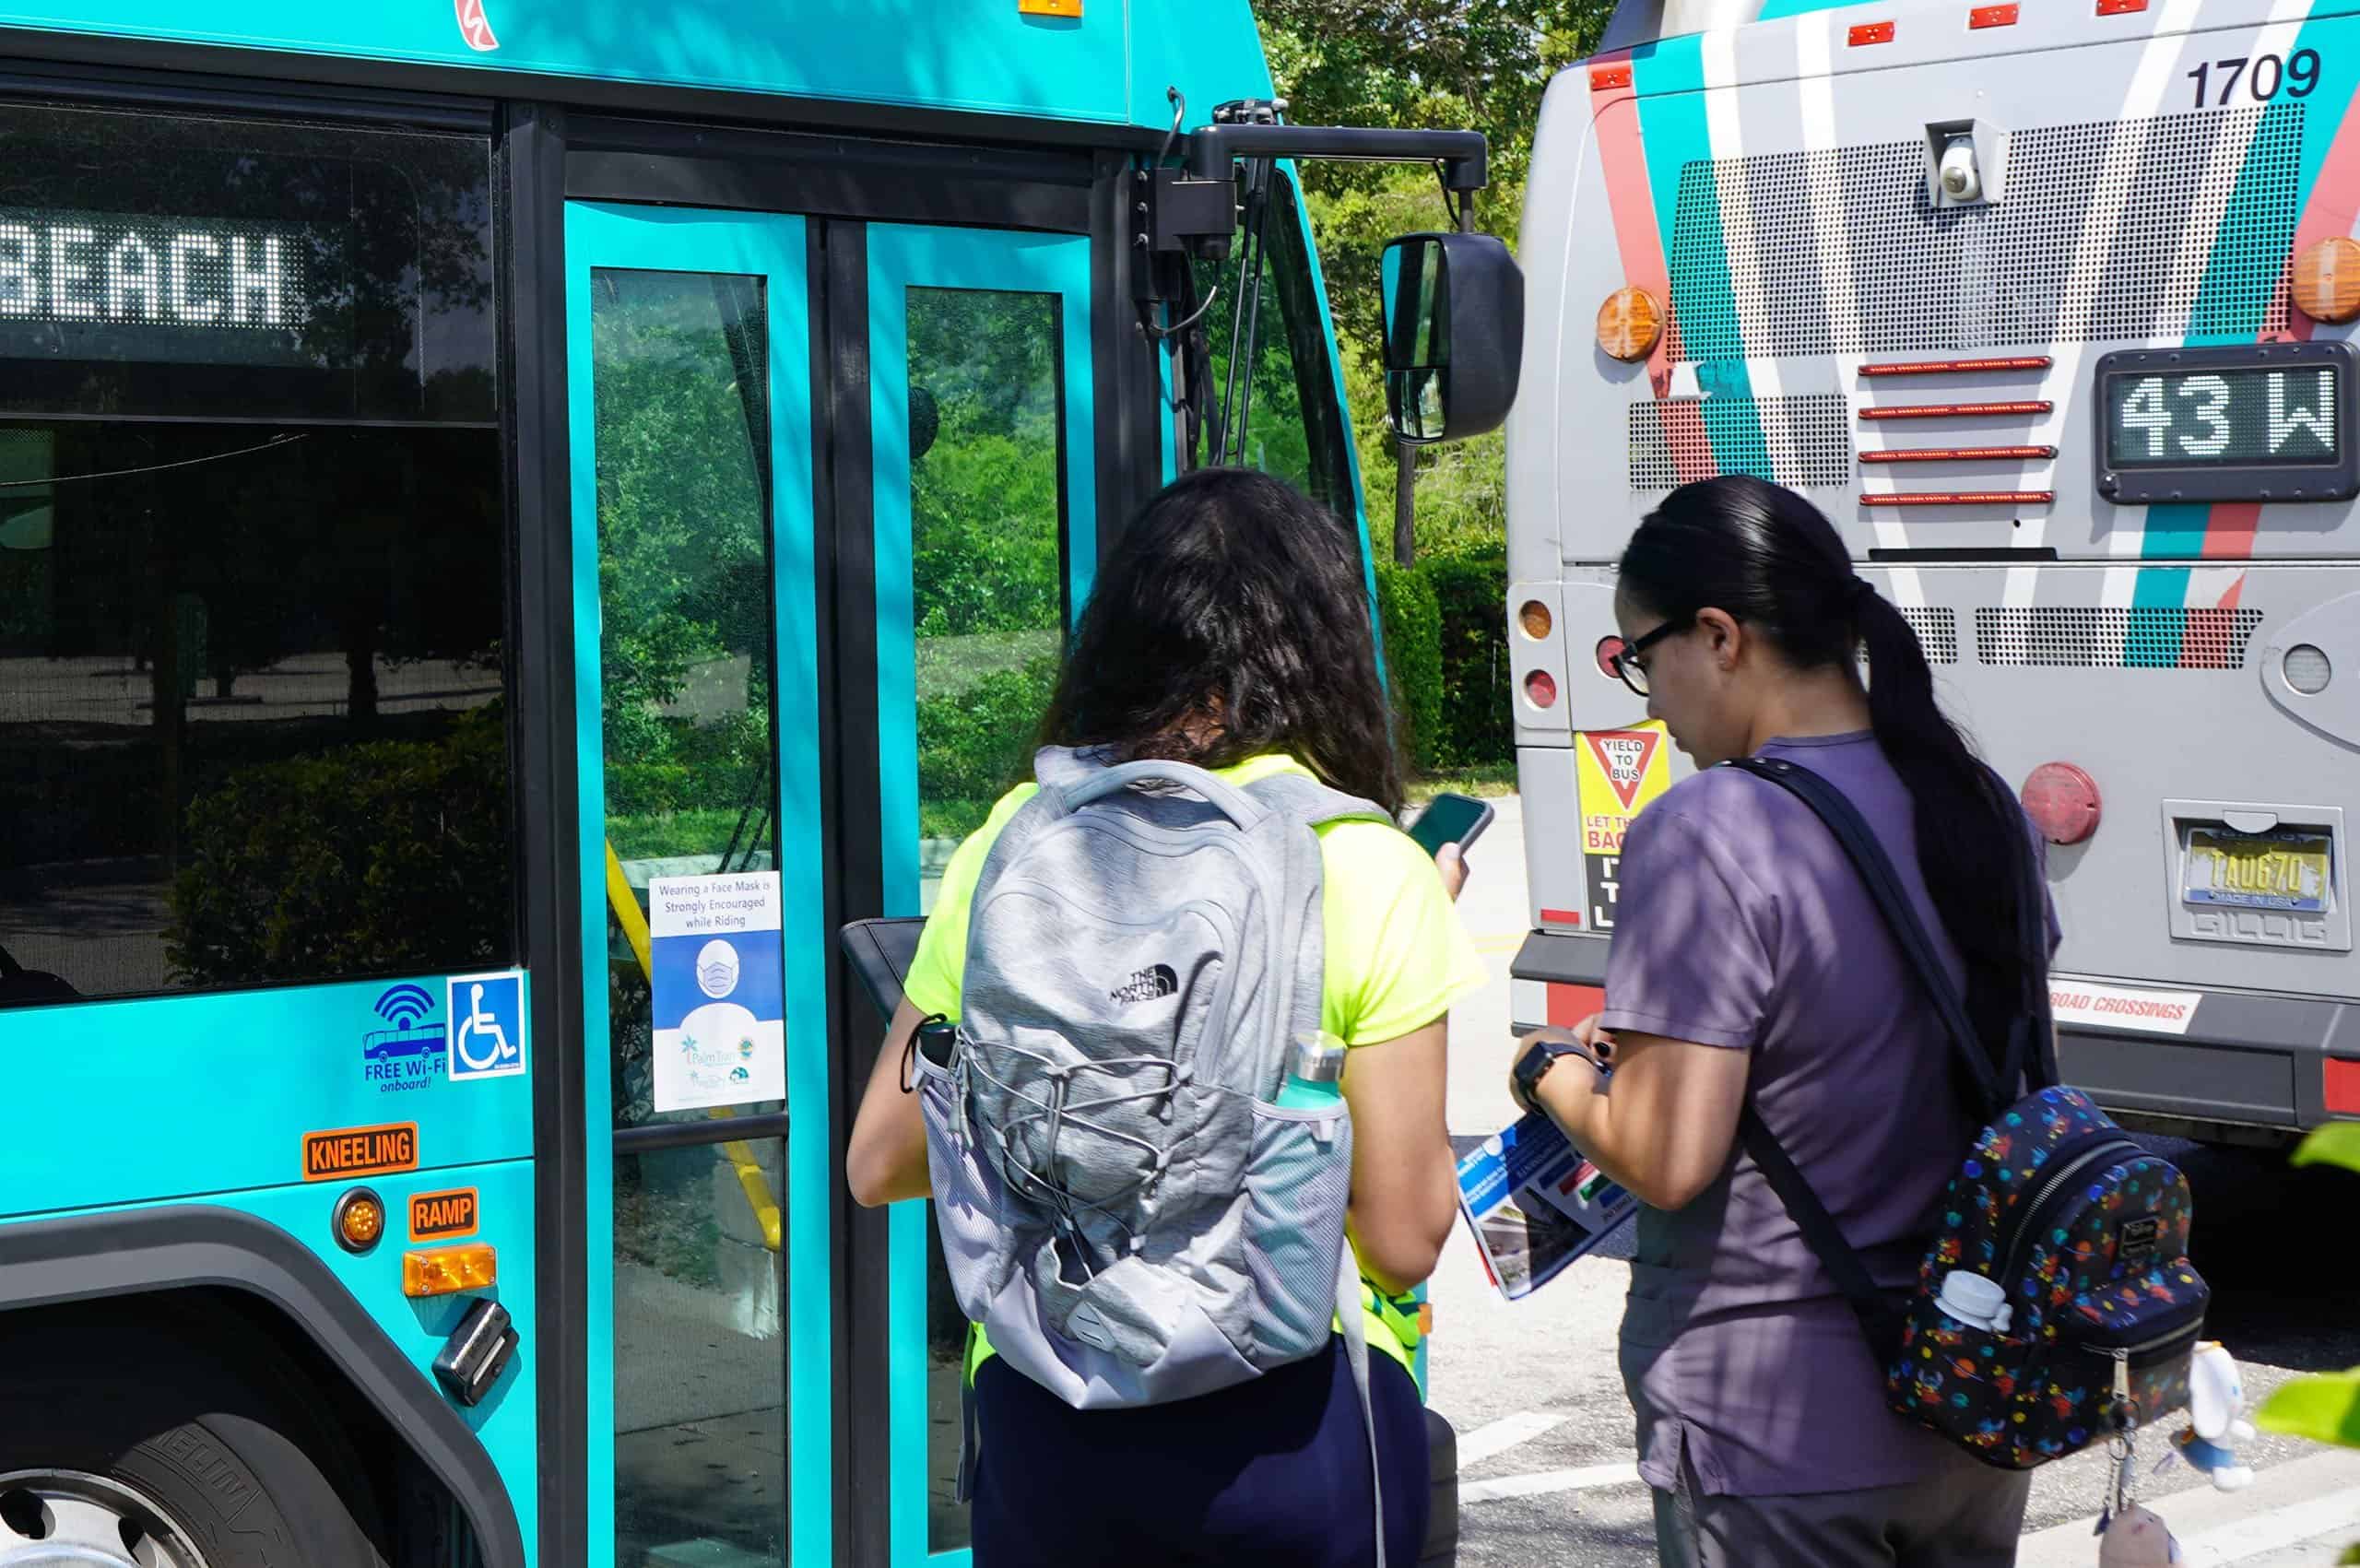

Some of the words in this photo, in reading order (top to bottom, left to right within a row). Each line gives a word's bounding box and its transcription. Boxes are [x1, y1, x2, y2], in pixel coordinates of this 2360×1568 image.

[2187, 48, 2321, 109] 1709
[0, 224, 281, 324] BEACH
[2122, 374, 2230, 456] 43
[2268, 371, 2335, 454] W
[1604, 740, 1643, 752] YIELD
[1615, 755, 1633, 766] TO
[1612, 768, 1639, 781] BUS
[1587, 816, 1610, 828] LET
[1587, 831, 1624, 849] BAC
[659, 884, 701, 897] Wearing
[712, 883, 732, 893] Face
[736, 881, 761, 891] Mask
[665, 900, 706, 914] Strongly
[709, 896, 765, 911] Encouraged
[2216, 891, 2248, 903] MADE
[2250, 893, 2264, 905] IN
[2267, 896, 2295, 908] USA
[686, 917, 712, 929] while
[714, 915, 746, 927] Riding
[1130, 966, 1156, 984] THE
[1109, 980, 1156, 1002] NORTH
[1119, 991, 1156, 1007] FACE
[2094, 996, 2187, 1020] CROSSINGS
[365, 1061, 402, 1081] FREE
[406, 1058, 446, 1077] Wi-Fi
[380, 1075, 432, 1093] onboard!
[310, 1131, 410, 1171] KNEELING
[415, 1197, 472, 1230] RAMP
